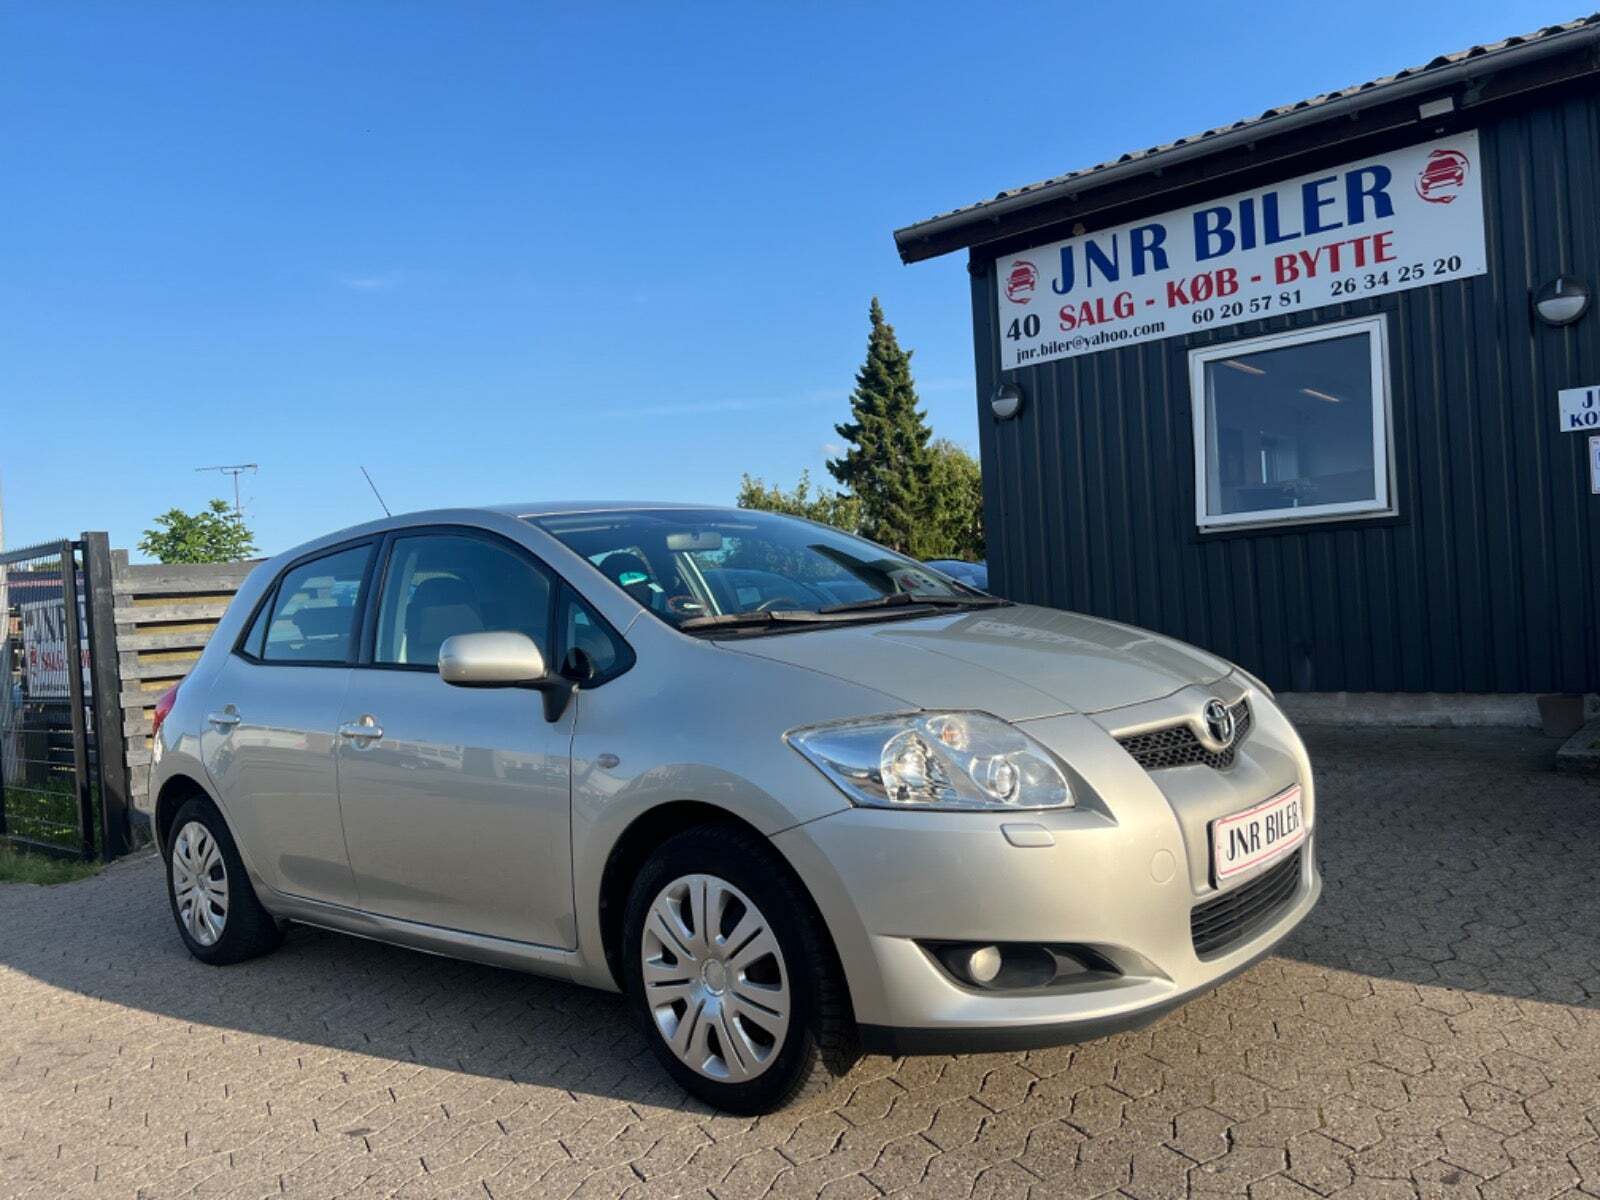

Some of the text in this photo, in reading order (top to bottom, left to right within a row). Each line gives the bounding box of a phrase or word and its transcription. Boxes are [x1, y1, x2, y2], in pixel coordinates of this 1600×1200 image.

[1052, 164, 1395, 295] JNR BILER
[1059, 291, 1135, 332] SALG
[1166, 268, 1239, 308] KØB
[1274, 230, 1397, 285] BYTTE
[1331, 255, 1462, 296] 26 34 25 20
[1006, 313, 1041, 341] 40
[1192, 289, 1301, 325] 60 20 57 81
[1016, 319, 1166, 364] jnr.biler@yahoo.com
[1570, 410, 1600, 428] KO
[1582, 388, 1600, 409] J
[1226, 801, 1300, 861] JNR BILER
